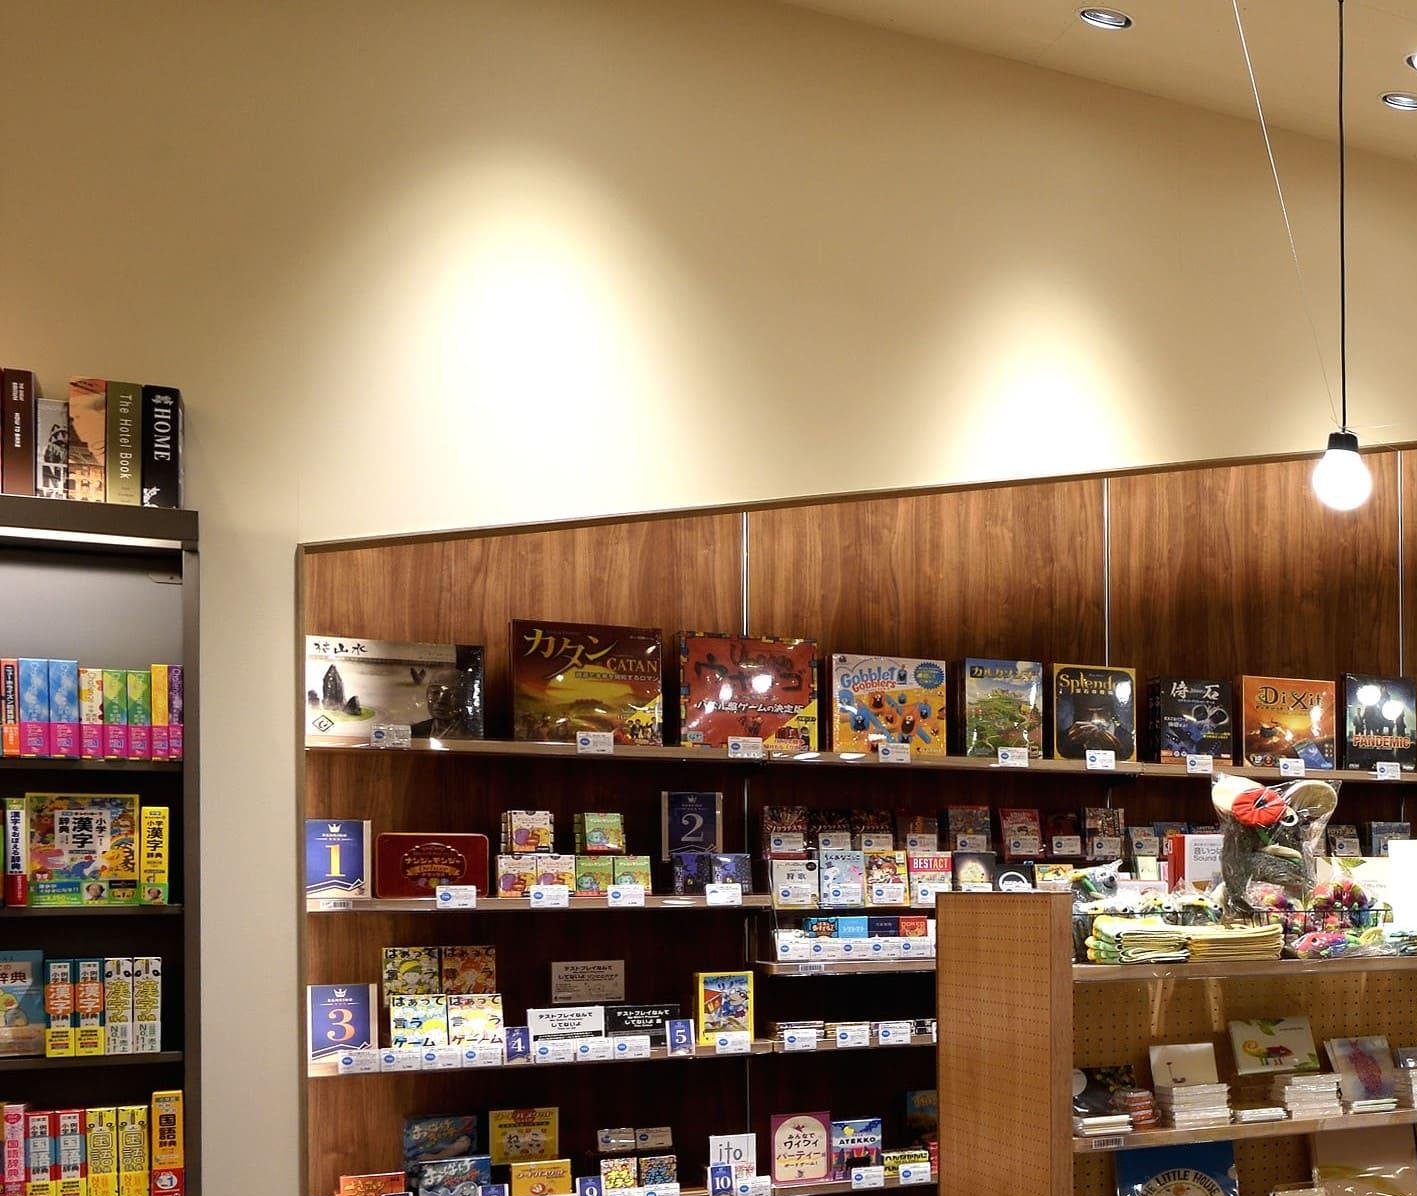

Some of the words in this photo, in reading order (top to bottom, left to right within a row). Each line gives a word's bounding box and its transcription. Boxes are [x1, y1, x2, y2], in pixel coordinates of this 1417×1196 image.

[119, 395, 132, 414] The
[119, 419, 132, 449] Hotel
[153, 408, 172, 461] HOME
[119, 453, 132, 479] Book
[522, 628, 618, 680] カタン
[606, 657, 658, 673] CATAN
[840, 666, 898, 689] Gobblet
[851, 679, 897, 694] Gobblers
[1352, 734, 1412, 750] PANDEMIC
[58, 816, 70, 834] 辞典
[72, 815, 94, 849] 漢字
[680, 812, 705, 843] 2
[146, 827, 164, 849] 漢字
[324, 843, 347, 878] 1
[49, 982, 71, 1014] 漢字
[78, 982, 101, 1014] 漢字
[326, 1008, 357, 1042] 3
[675, 1029, 688, 1044] 5
[509, 1036, 523, 1053] 4
[158, 1115, 177, 1140] 国語
[718, 1143, 743, 1162] ito
[837, 1135, 877, 1146] ATEKKO
[714, 1174, 731, 1190] 10
[1156, 1170, 1190, 1187] LITTLE
[1192, 1171, 1220, 1196] HOUSE
